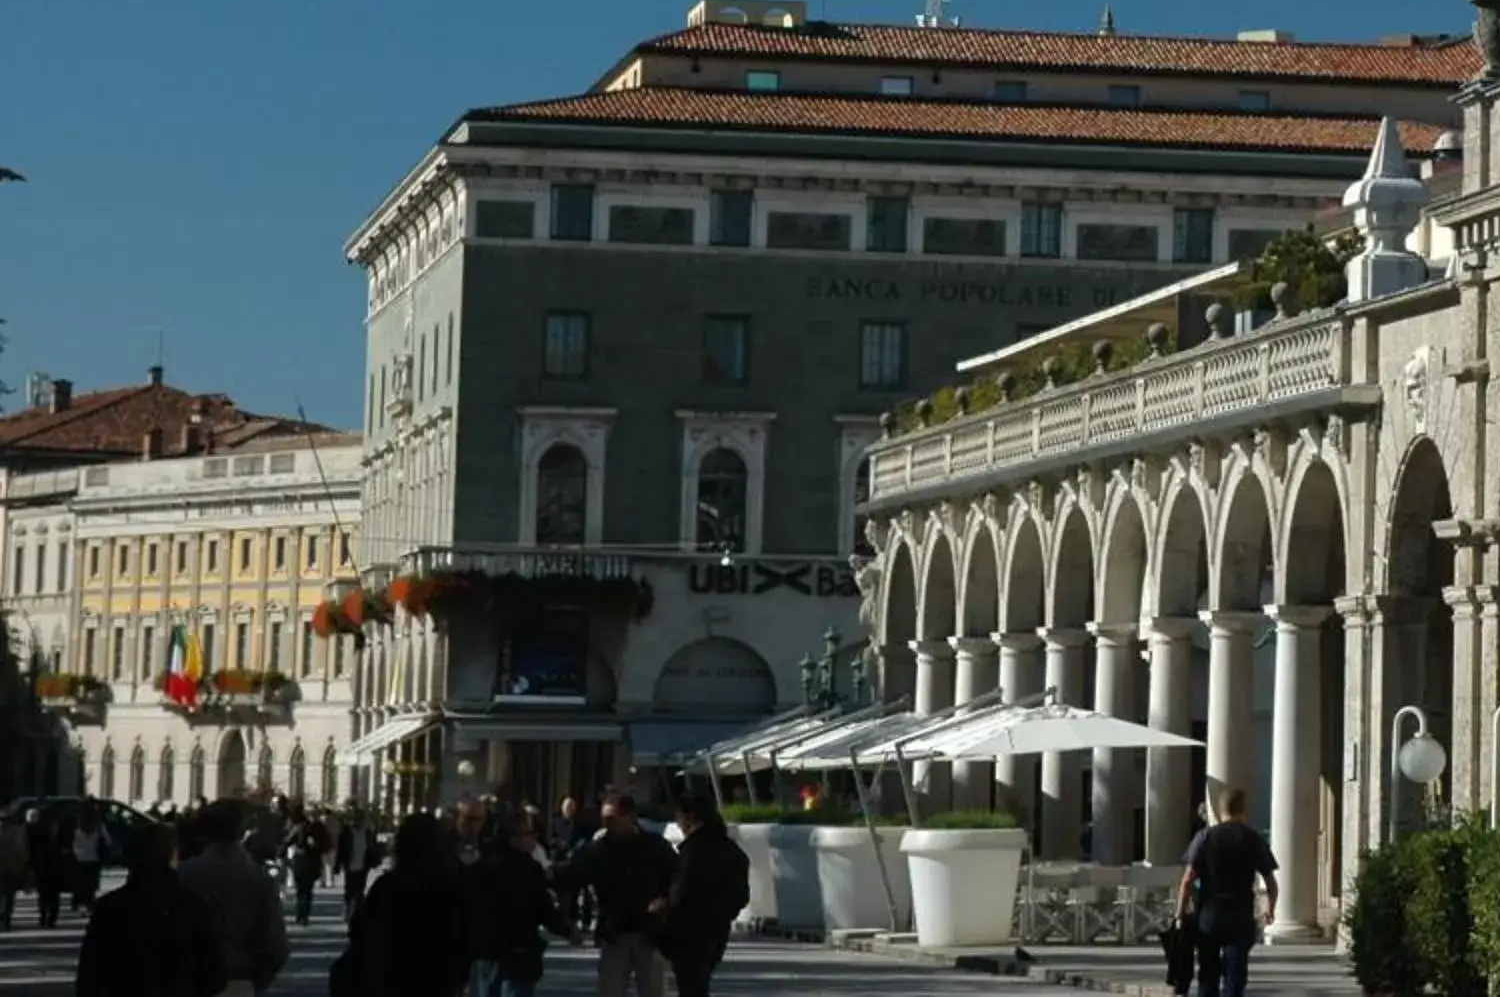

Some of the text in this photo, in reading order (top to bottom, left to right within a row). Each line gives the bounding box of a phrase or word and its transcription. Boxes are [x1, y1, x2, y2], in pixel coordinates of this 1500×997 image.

[807, 276, 901, 301] BANCA
[922, 279, 1074, 308] POPOLARE
[690, 564, 861, 597] UBI Ba
